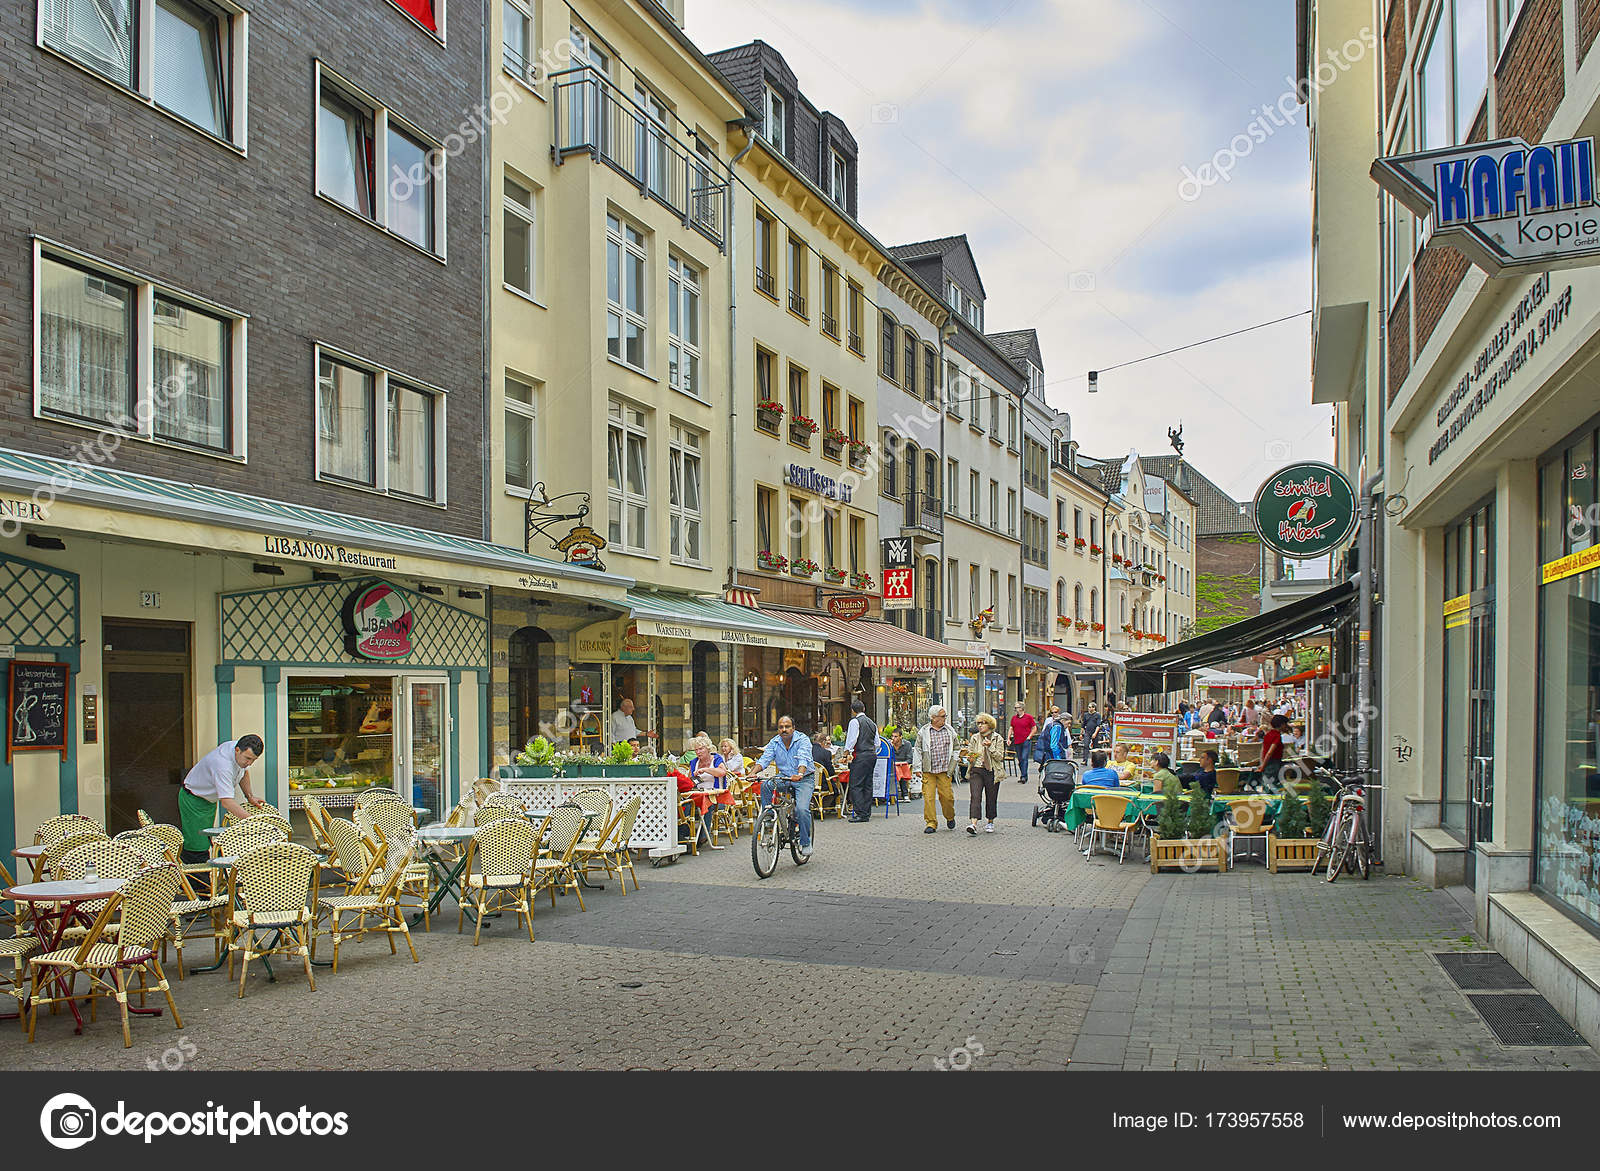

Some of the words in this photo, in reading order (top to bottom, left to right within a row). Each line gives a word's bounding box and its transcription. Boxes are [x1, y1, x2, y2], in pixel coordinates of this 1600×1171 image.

[1517, 212, 1598, 246] Kopie
[1511, 270, 1550, 337] STICKEN
[1538, 284, 1572, 346] STOFF
[1273, 475, 1332, 498] Schnitzel
[1278, 517, 1337, 543] Huber
[264, 535, 336, 562] LIBANON
[337, 546, 397, 570] Restaurant
[887, 540, 908, 563] WMF
[144, 592, 156, 606] 21
[361, 617, 409, 634] LIBANON
[369, 636, 401, 648] Express
